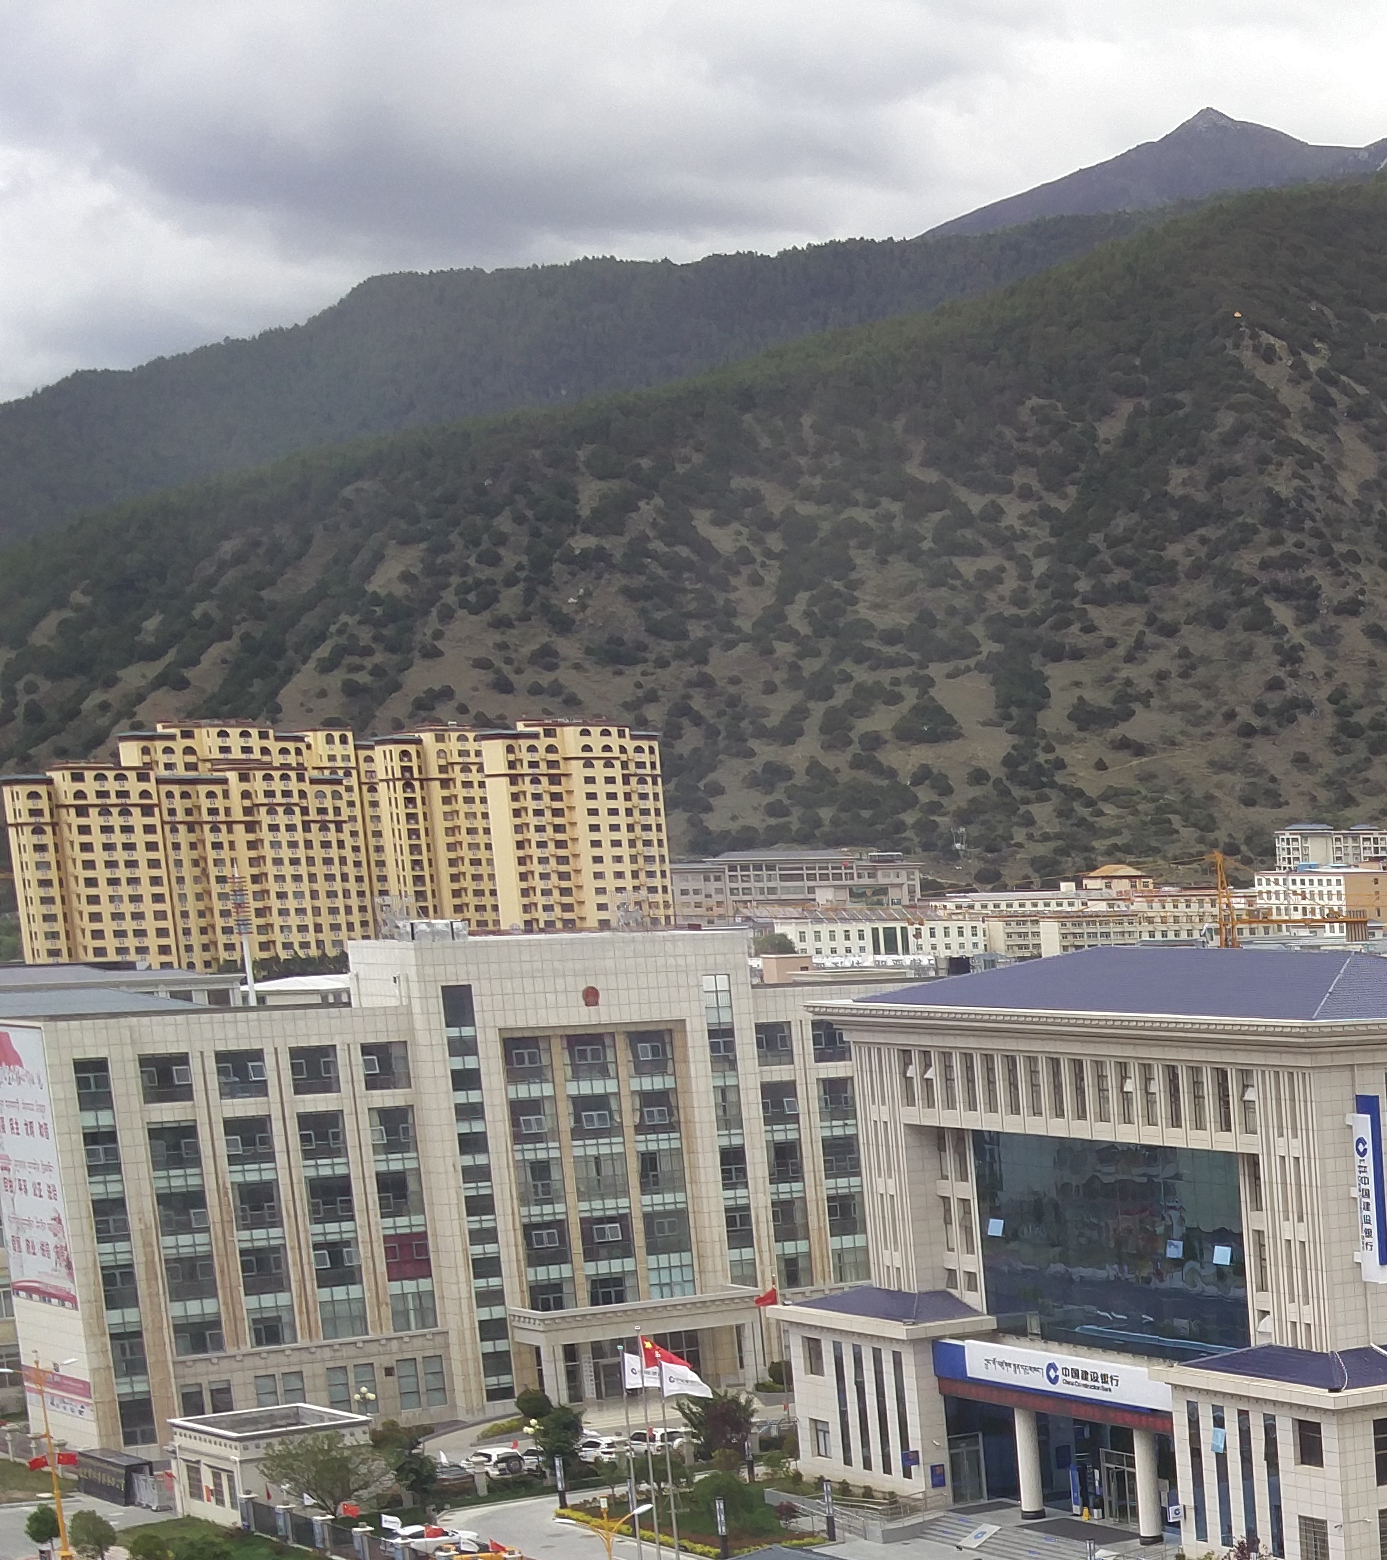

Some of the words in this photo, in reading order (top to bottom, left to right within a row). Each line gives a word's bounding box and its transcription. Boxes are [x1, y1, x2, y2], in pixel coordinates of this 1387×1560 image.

[1061, 1366, 1120, 1388] 中国建设银行
